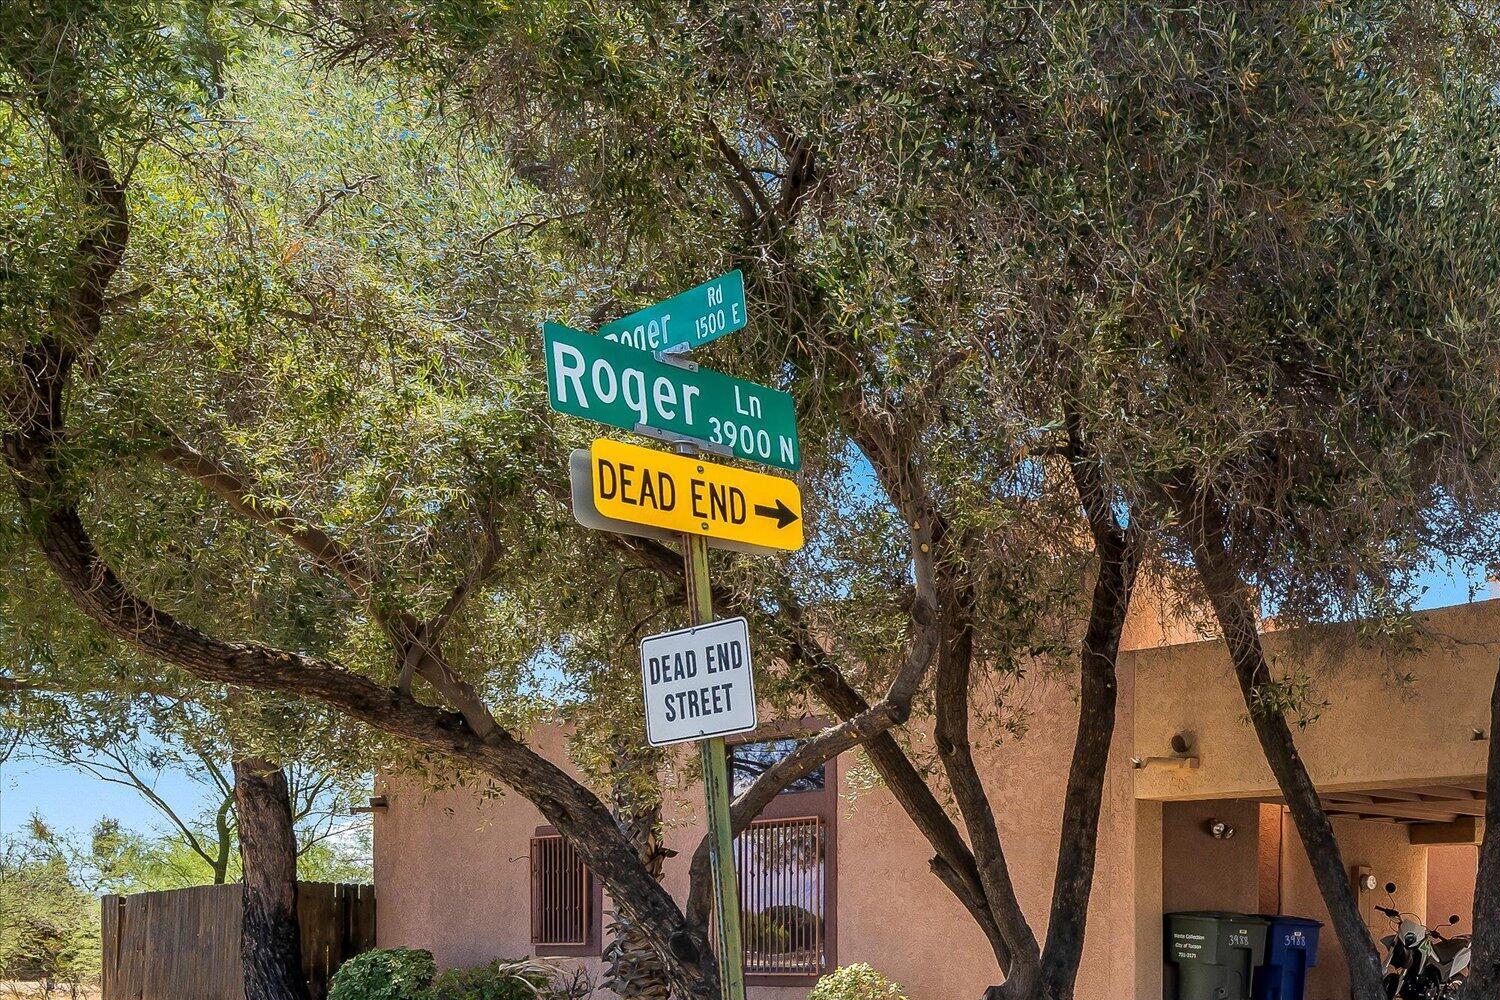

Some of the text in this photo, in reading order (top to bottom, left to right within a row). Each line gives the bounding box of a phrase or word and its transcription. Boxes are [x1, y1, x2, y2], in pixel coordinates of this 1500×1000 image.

[707, 283, 723, 308] Rd
[603, 313, 671, 351] oger
[695, 303, 740, 340] 1500 E
[552, 340, 700, 426] Roger
[734, 385, 762, 419] Ln
[708, 416, 795, 465] 3900 N
[598, 458, 746, 525] DEAD END
[649, 640, 743, 685] DEAD END
[664, 683, 733, 723] STREET
[1228, 934, 1249, 946] 3988
[1283, 934, 1306, 947] 3988
